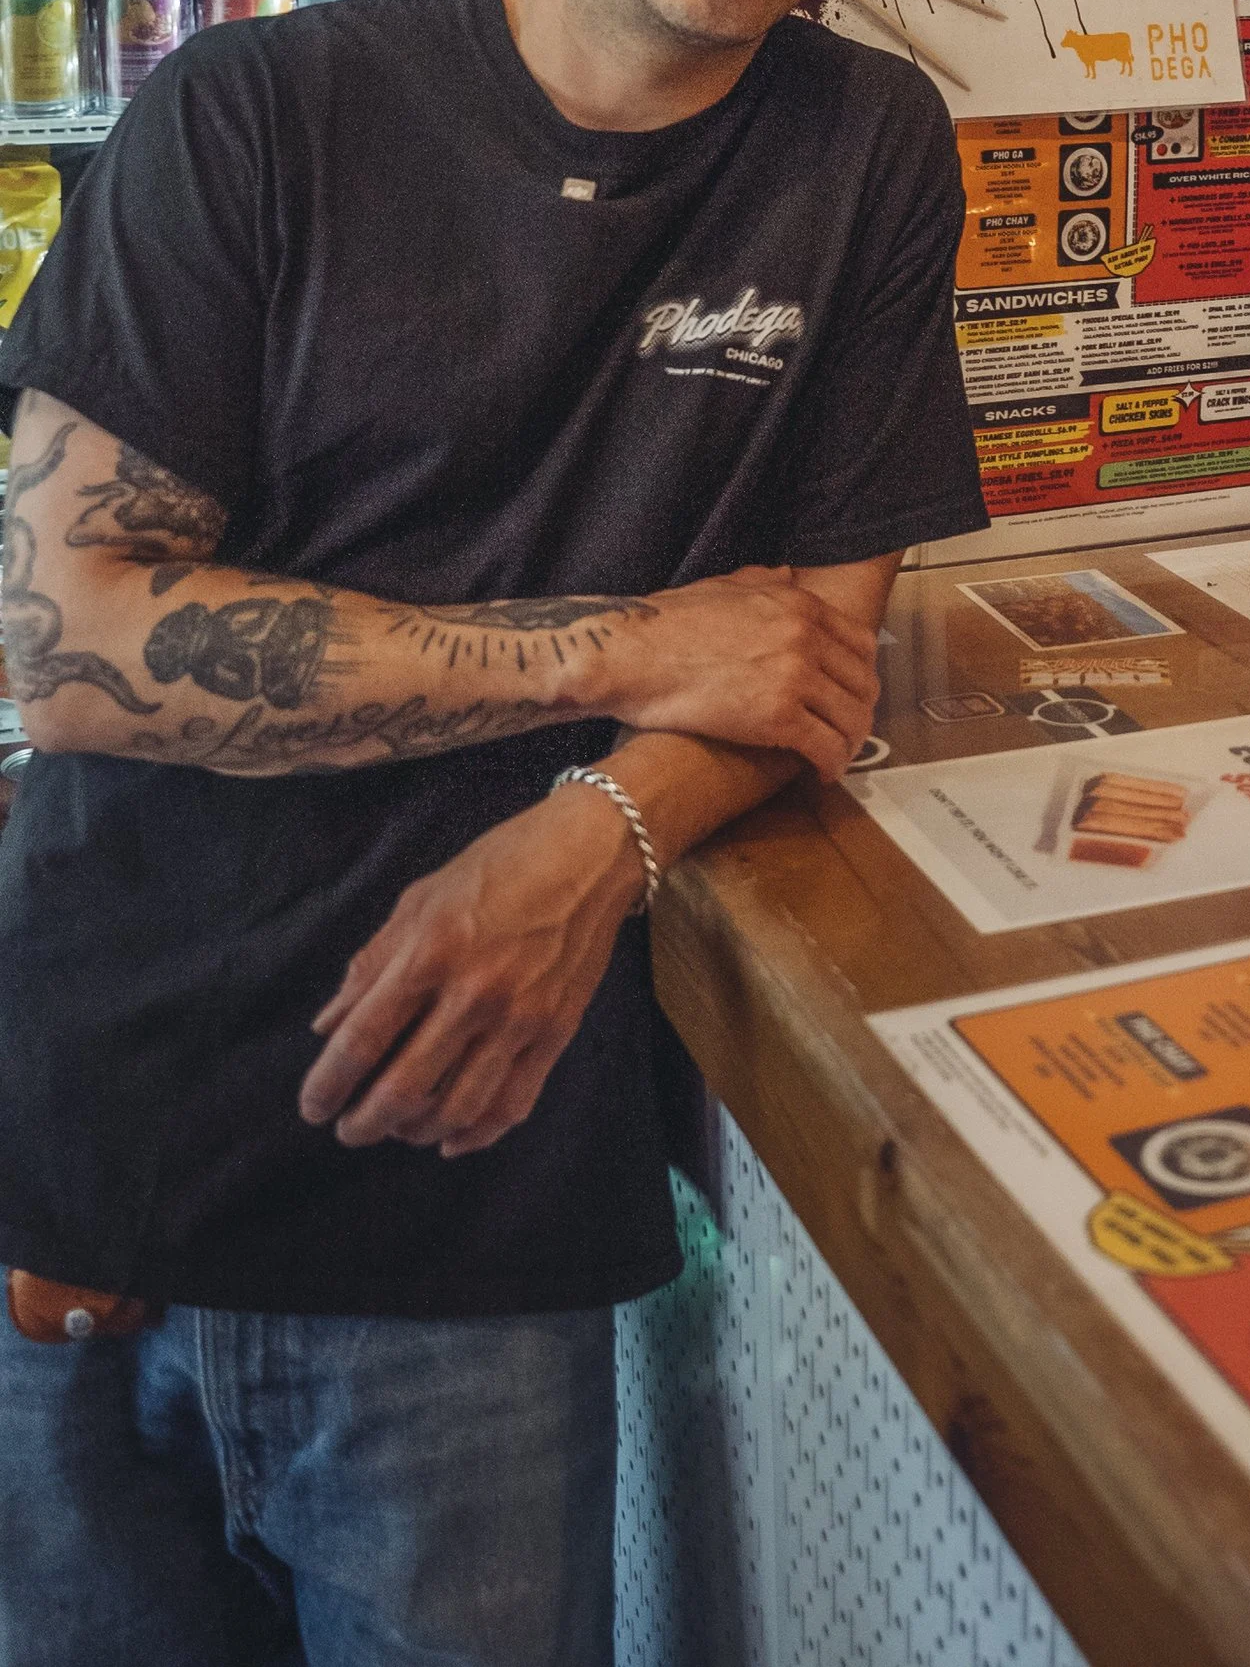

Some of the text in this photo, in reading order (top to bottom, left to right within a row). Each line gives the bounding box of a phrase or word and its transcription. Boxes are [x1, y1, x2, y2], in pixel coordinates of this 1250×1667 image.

[1147, 21, 1209, 55] PHO
[1150, 55, 1212, 81] DEGA
[993, 150, 1024, 160] PHO GA
[1169, 175, 1197, 183] OVER
[1198, 173, 1231, 181] WHITE
[985, 216, 1029, 226] PHO CHAY
[965, 288, 1109, 313] SANDWICHES
[638, 287, 802, 352] Phodega
[965, 348, 983, 357] SPICY
[985, 345, 1011, 355] CHICKEN
[1081, 343, 1098, 351] PORK
[1098, 341, 1117, 349] BELLY
[725, 346, 784, 371] CHICAGO
[1146, 363, 1200, 375] ADD FRIES FOR
[1115, 403, 1132, 411] SALT
[1142, 398, 1168, 408] PEPPER
[1207, 396, 1230, 408] CRACK
[984, 404, 1057, 422] SNACKS
[1109, 408, 1173, 424] CHICKEN SKINS
[998, 452, 1022, 462] STYLE
